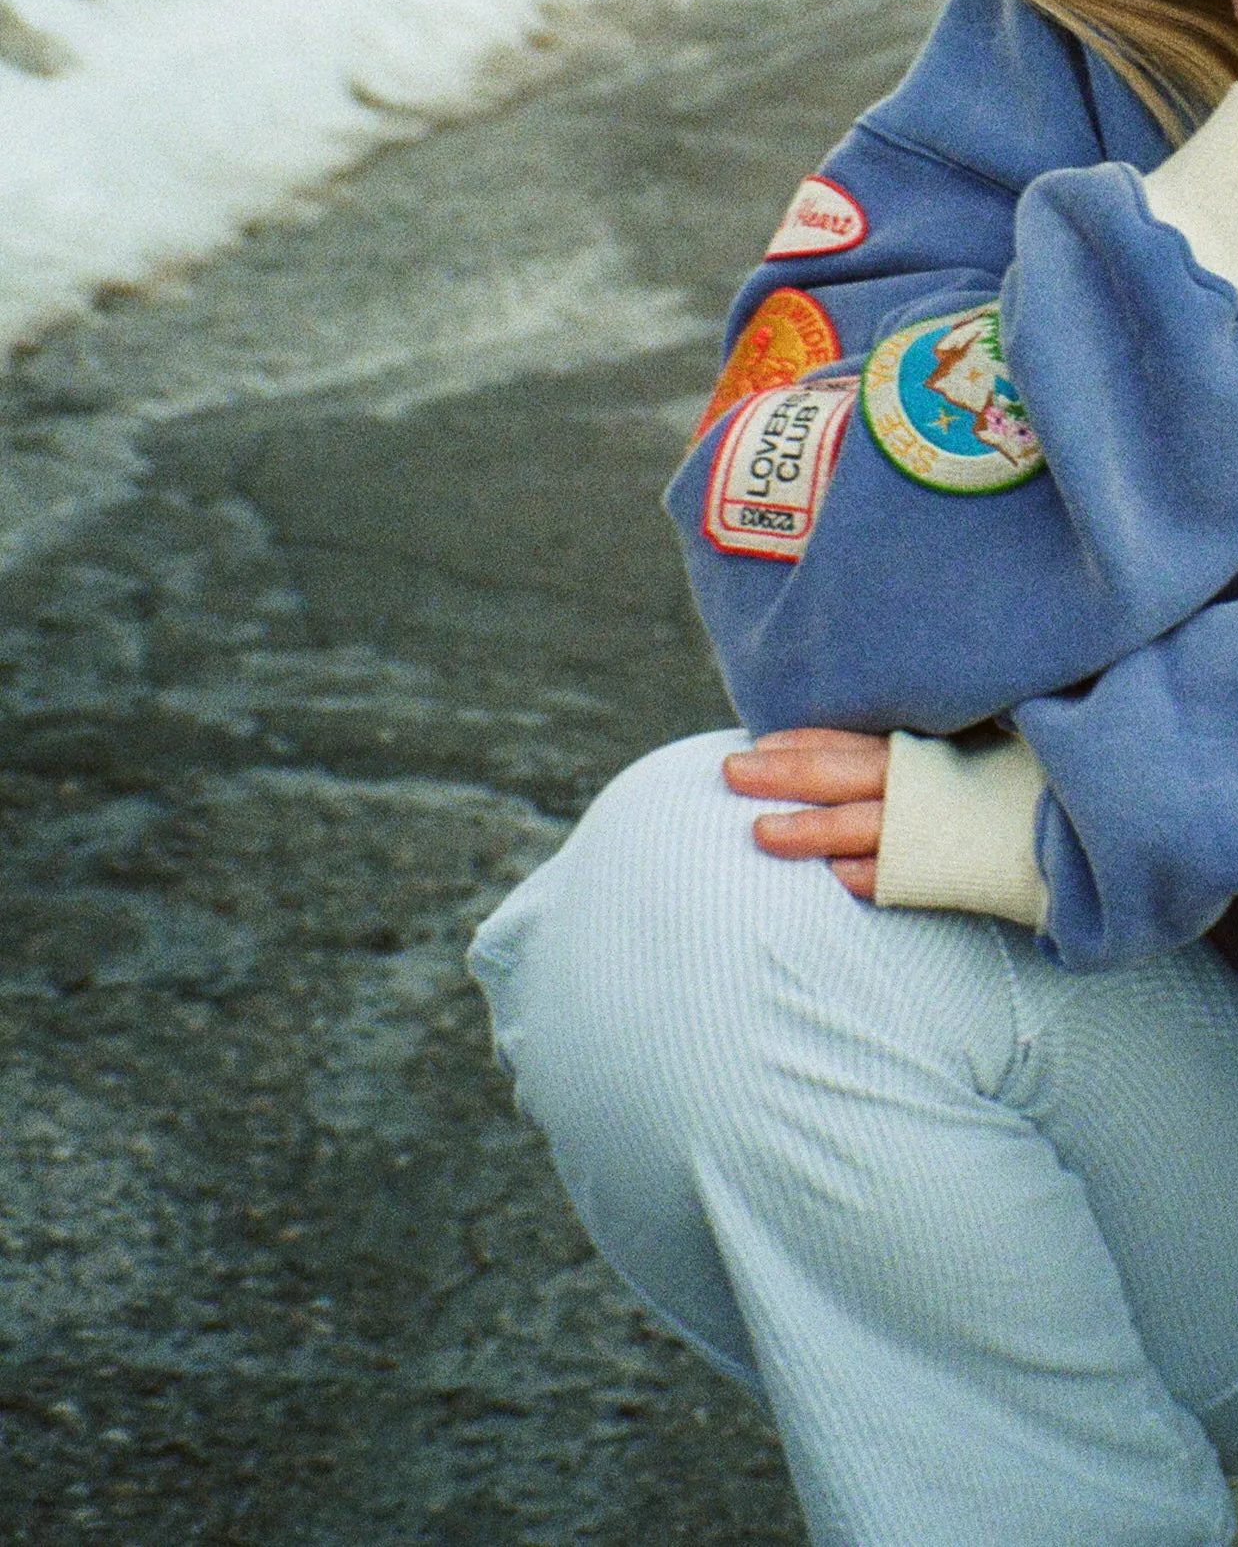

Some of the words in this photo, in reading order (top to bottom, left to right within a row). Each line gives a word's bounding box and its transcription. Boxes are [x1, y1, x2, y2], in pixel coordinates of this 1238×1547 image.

[868, 333, 912, 392] YOU
[775, 404, 819, 483] CLUB
[876, 405, 937, 474] SEE
